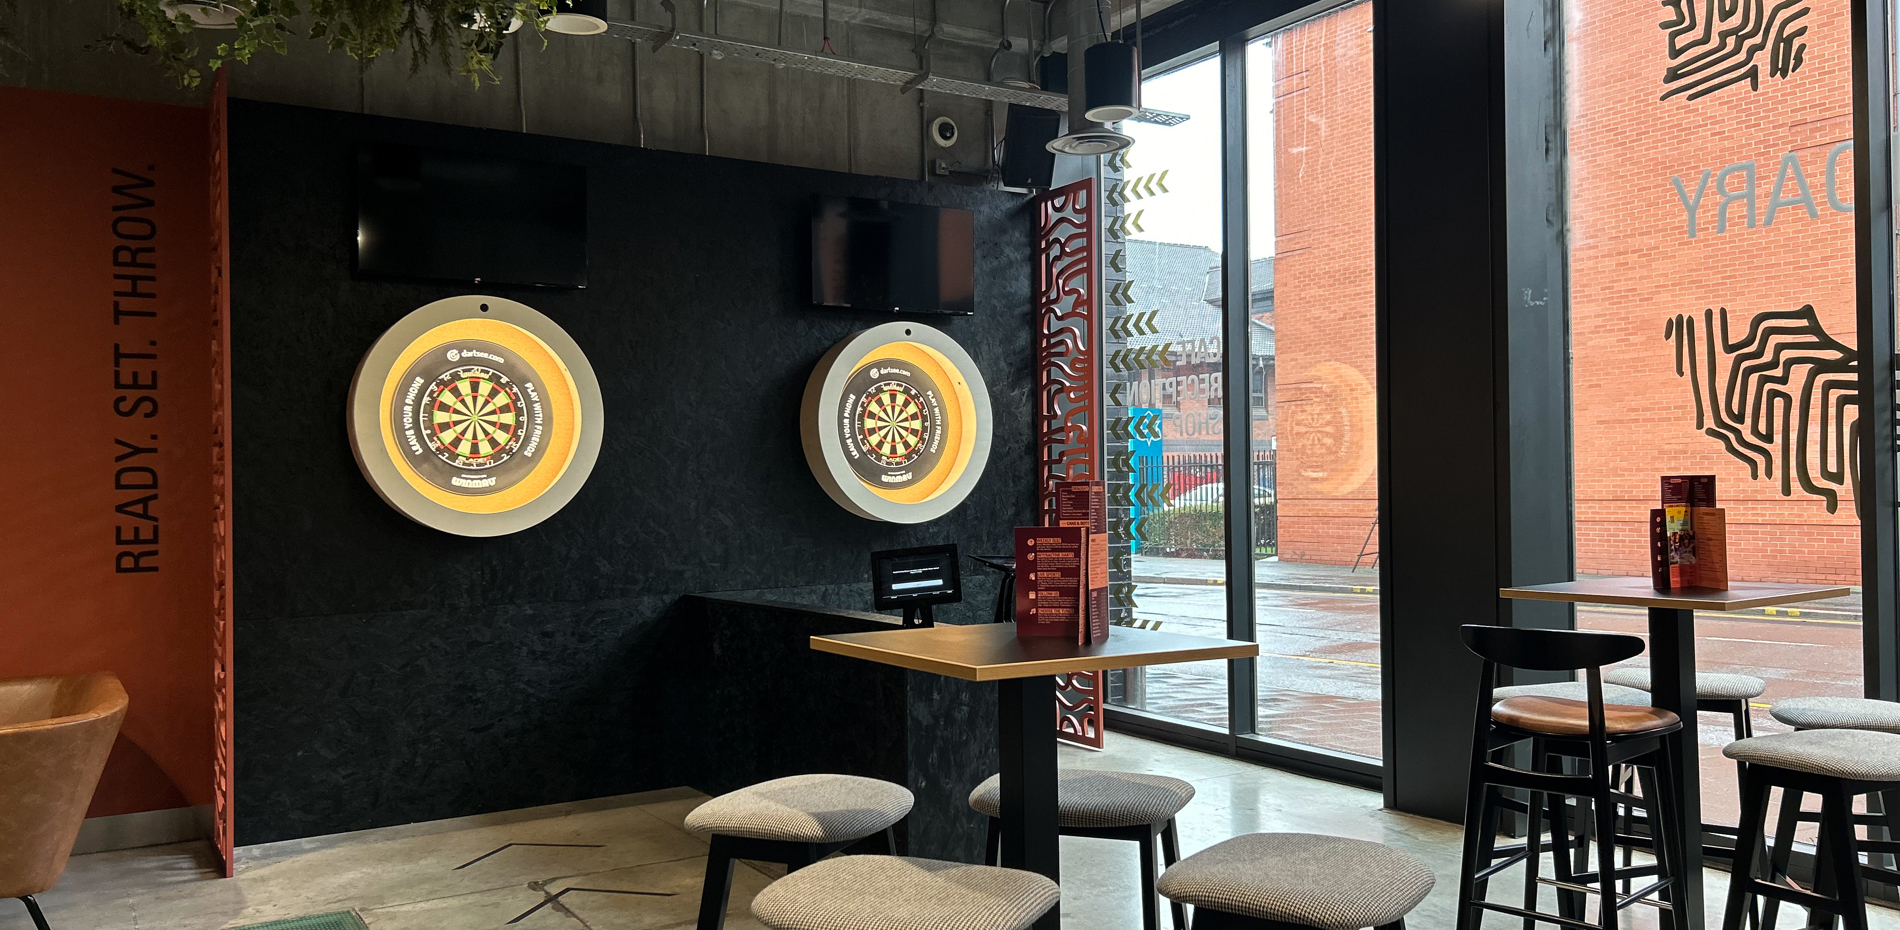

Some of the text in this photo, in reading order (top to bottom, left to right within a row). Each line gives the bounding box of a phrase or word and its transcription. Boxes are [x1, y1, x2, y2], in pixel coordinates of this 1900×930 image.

[111, 164, 160, 574] READY. SET. THROW.
[461, 349, 505, 364] dartsee.com
[880, 366, 911, 377] dartsee.com
[402, 376, 425, 456] LEAVE YOUR PHONE
[524, 382, 543, 458] PLAY WITH FRIENDS
[926, 390, 942, 454] PLAY WITH FRIENDS
